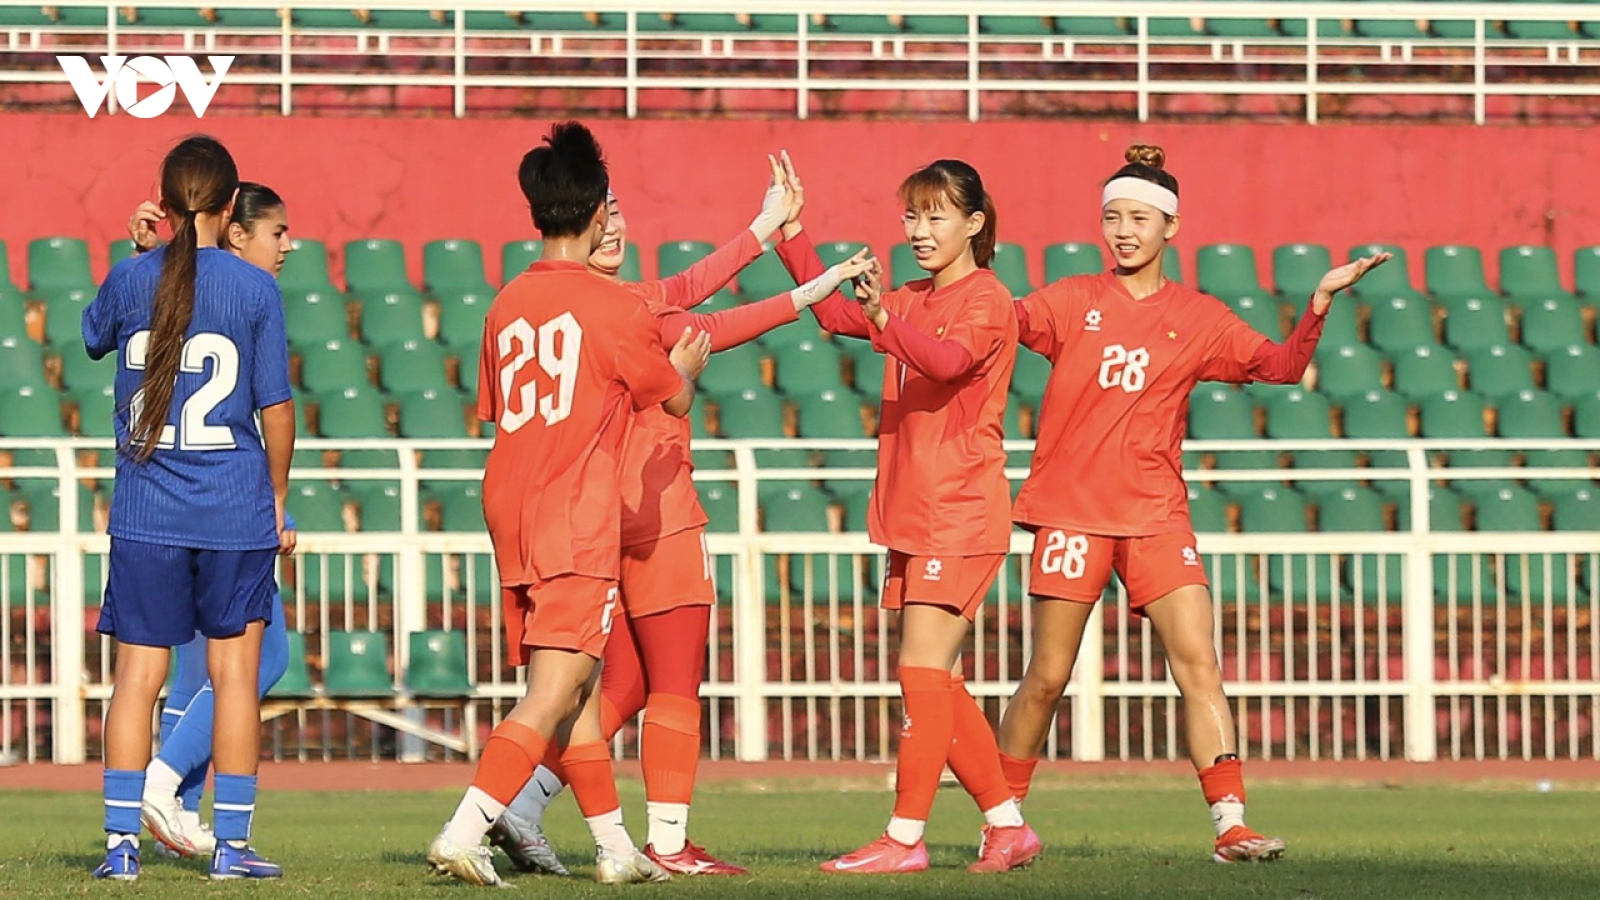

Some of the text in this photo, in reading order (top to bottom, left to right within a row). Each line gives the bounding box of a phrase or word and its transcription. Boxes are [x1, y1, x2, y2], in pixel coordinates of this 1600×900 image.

[497, 311, 583, 434] 29
[1098, 344, 1149, 392] 28
[1041, 530, 1088, 579] 28
